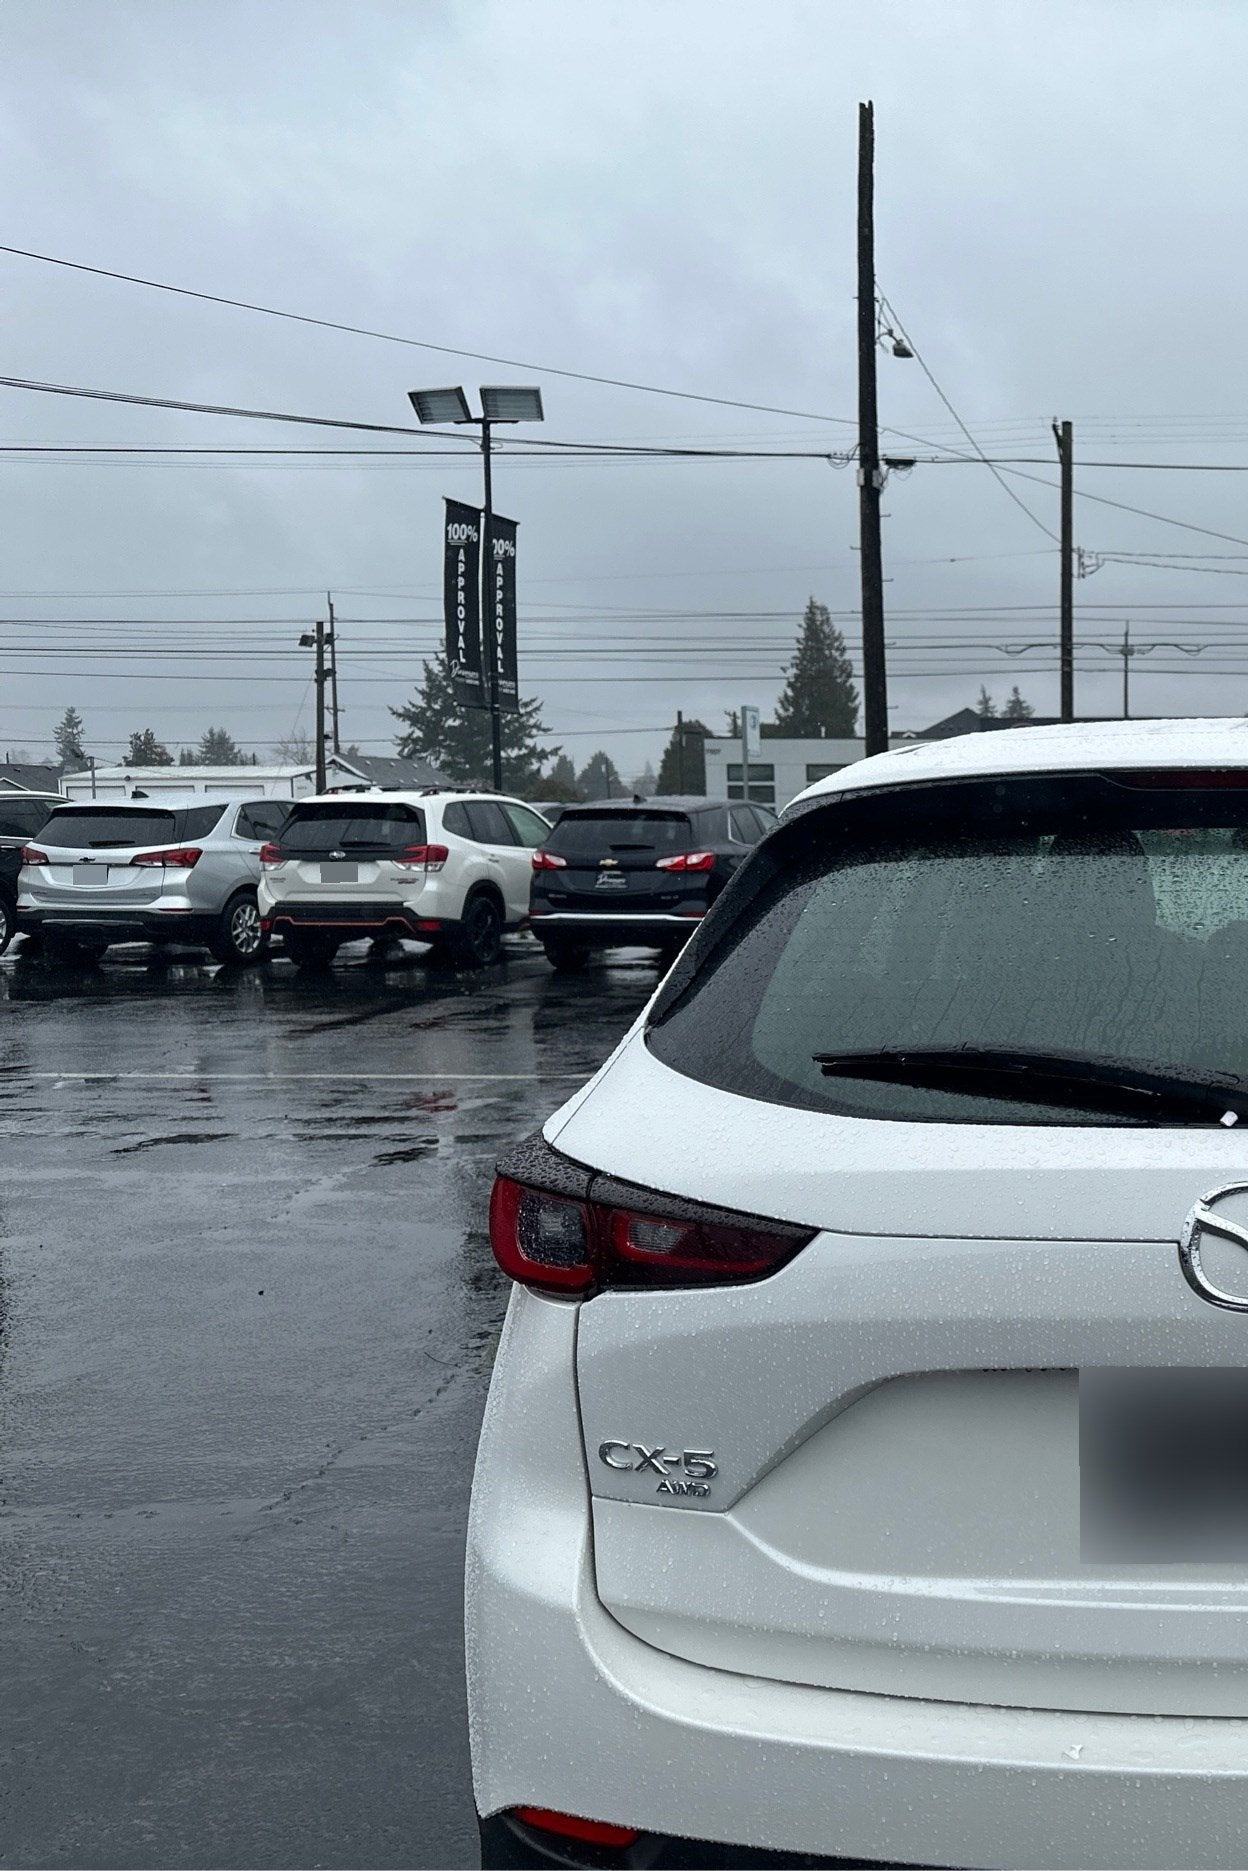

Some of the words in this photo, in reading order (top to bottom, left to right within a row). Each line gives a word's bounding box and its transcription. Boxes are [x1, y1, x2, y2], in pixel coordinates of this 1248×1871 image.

[447, 523, 478, 543] 100%
[492, 538, 515, 557] 00%
[457, 548, 466, 663] APPROVAL
[496, 563, 504, 673] APPROVAL
[598, 1439, 719, 1479] CX-5
[656, 1479, 711, 1497] AWD
